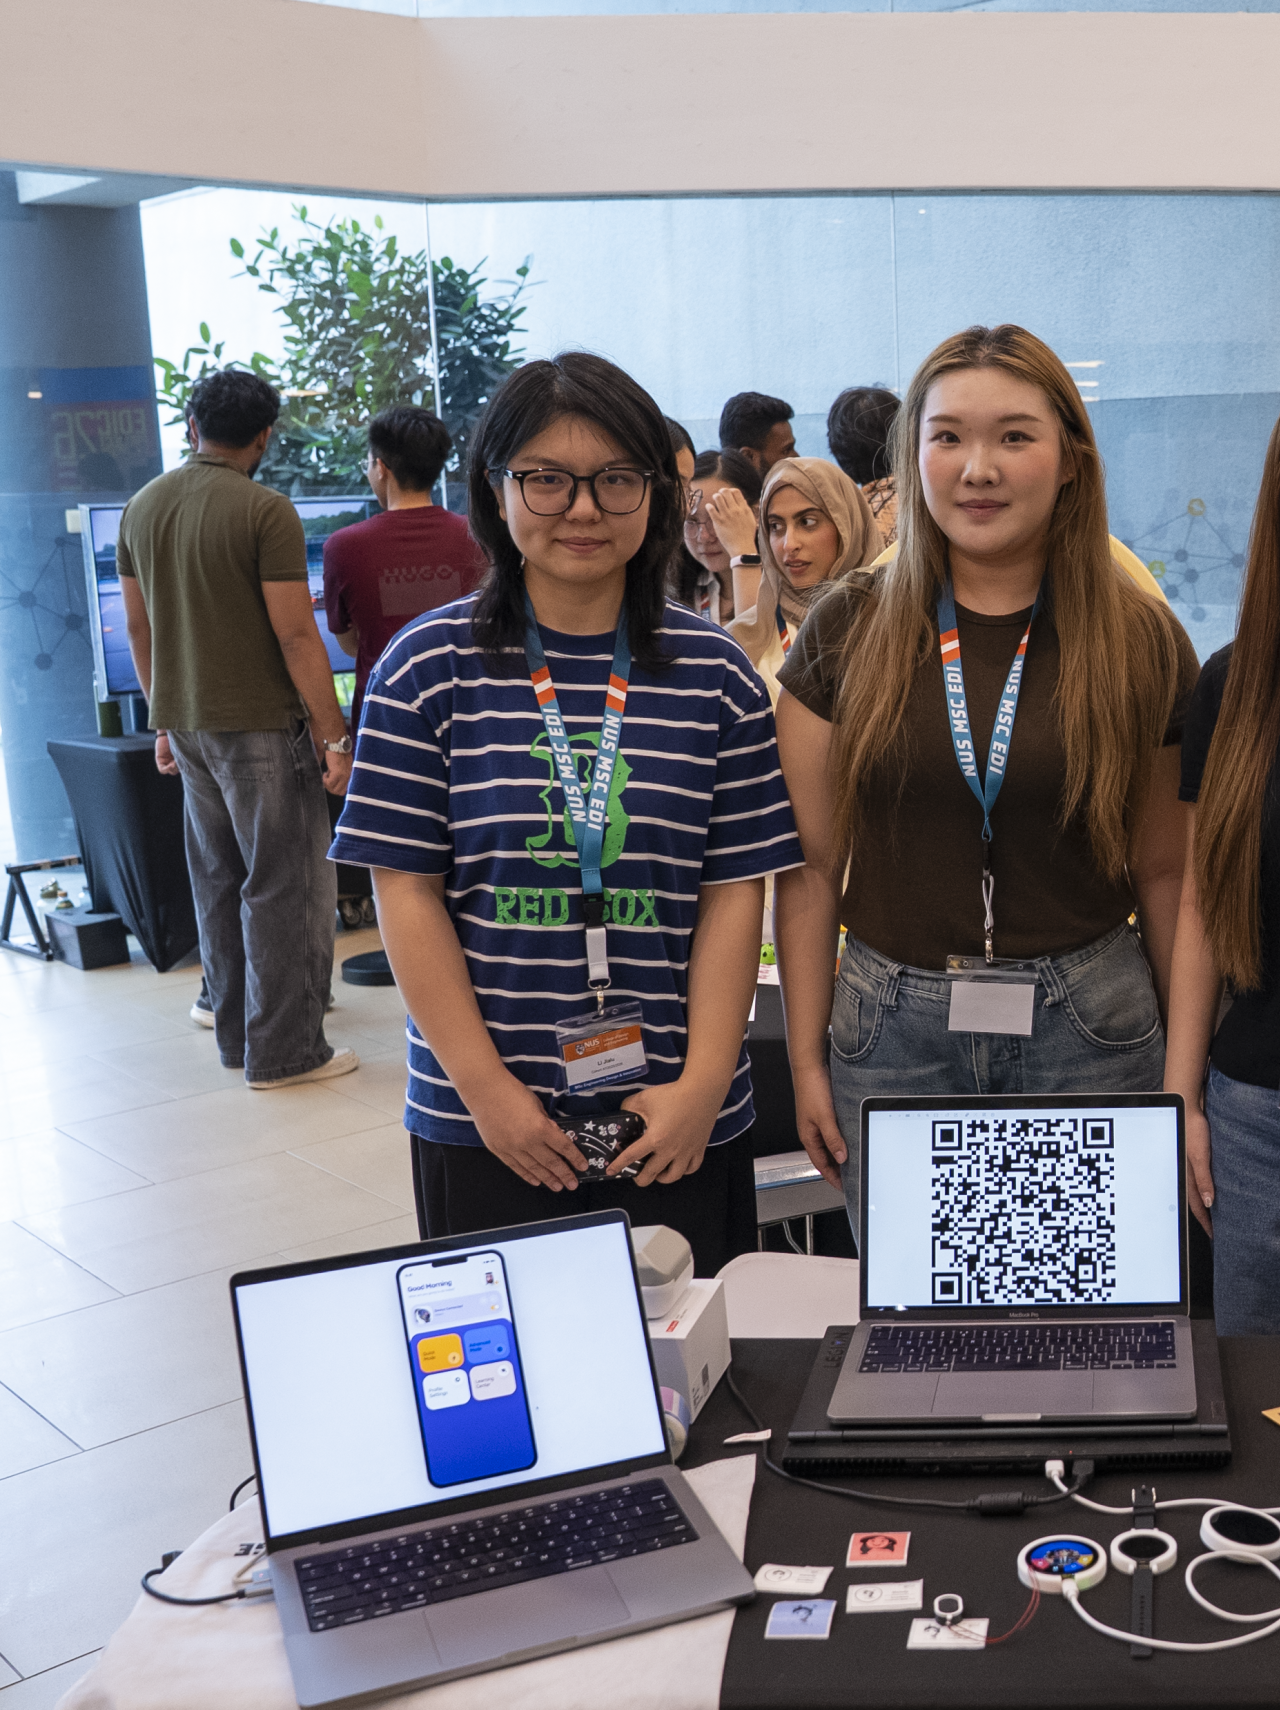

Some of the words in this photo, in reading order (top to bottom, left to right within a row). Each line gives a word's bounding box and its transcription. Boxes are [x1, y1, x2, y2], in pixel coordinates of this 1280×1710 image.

[384, 564, 452, 584] HUGO
[946, 666, 963, 694] EDI
[1006, 660, 1023, 694] NUS
[543, 707, 564, 737] EDI
[950, 698, 968, 733] MSC
[998, 699, 1014, 736] MSC
[602, 714, 619, 752] NUS
[556, 744, 577, 779] MSC
[593, 756, 612, 793] MSC
[956, 739, 976, 777] NUS
[990, 741, 1007, 775] EDI
[566, 785, 586, 822] NUS
[588, 797, 604, 831] EDI
[495, 887, 569, 926] RED
[584, 1039, 599, 1047] NUS
[584, 1079, 605, 1087] Engineering
[426, 1280, 452, 1288] Morning
